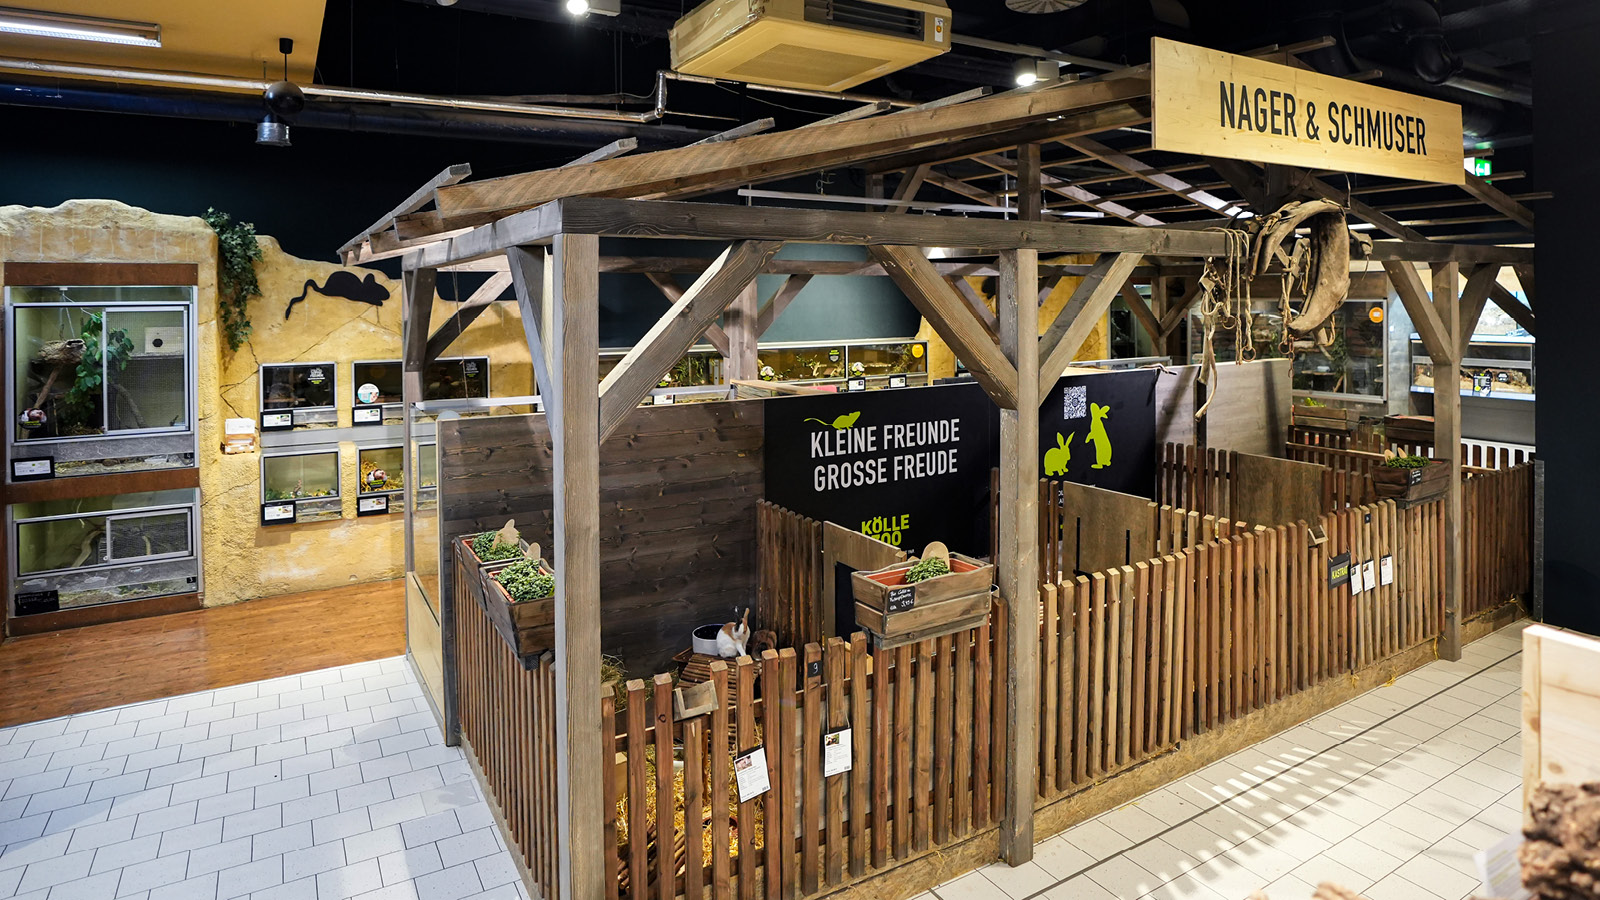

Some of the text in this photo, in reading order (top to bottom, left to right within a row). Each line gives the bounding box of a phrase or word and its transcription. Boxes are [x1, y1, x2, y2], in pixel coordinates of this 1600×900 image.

[1219, 80, 1427, 156] NAGER & SCHMUSER
[811, 418, 960, 459] KLEINE FREUNDE
[814, 448, 958, 492] GROSSE FREUDE
[861, 513, 910, 536] KÖLLE
[812, 662, 819, 674] 9
